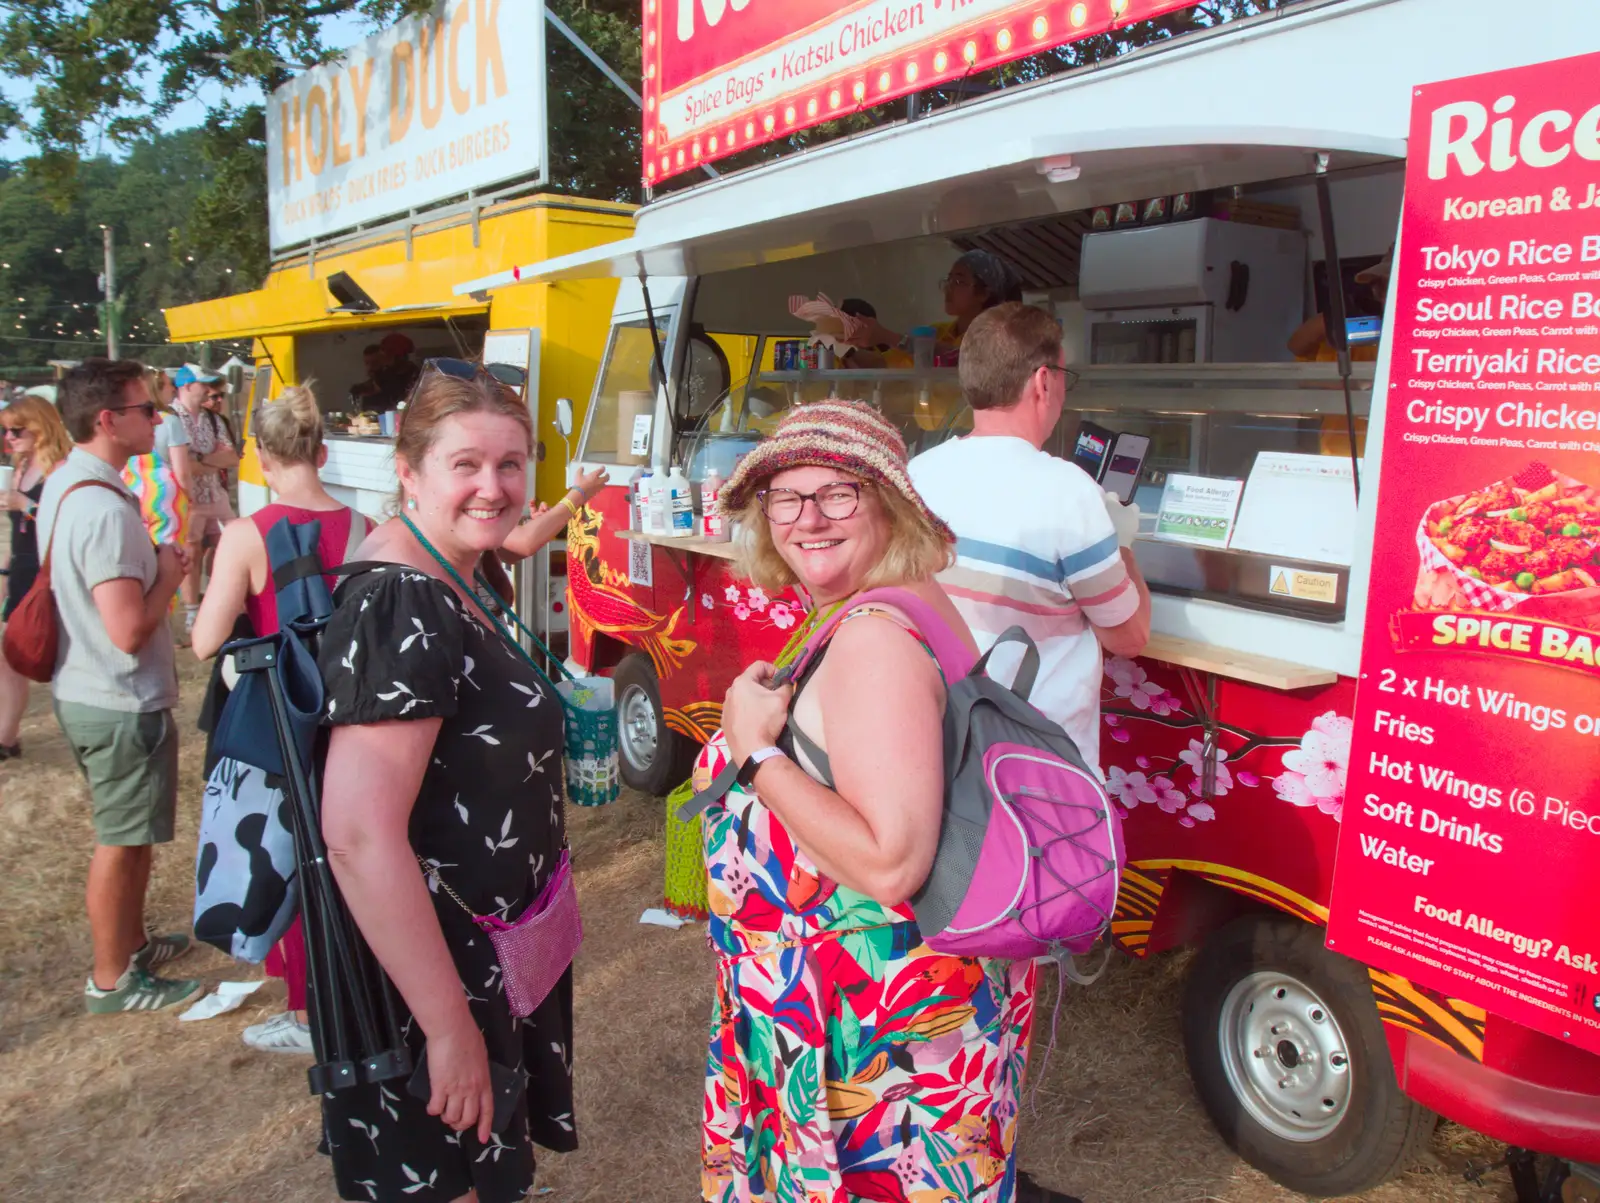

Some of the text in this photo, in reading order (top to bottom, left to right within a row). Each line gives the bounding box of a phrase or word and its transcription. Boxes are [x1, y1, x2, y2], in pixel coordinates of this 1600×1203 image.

[684, 2, 925, 125] Spice Bags Katsu Chicken
[281, 0, 509, 186] HOLY DUCK
[285, 121, 511, 226] DUCK WRAPS DUCK FRIES DUCK BURGERS
[1443, 195, 1542, 221] Korean
[1549, 187, 1572, 212] &
[1420, 244, 1500, 275] Tokyo
[1507, 239, 1572, 266] Rice
[1418, 278, 1446, 289] Crispy
[1447, 276, 1486, 287] Chicken,
[1488, 274, 1518, 285] Green
[1519, 273, 1546, 284] Peas,
[1548, 271, 1580, 282] Carrot
[1415, 295, 1493, 322] Seoul
[1499, 293, 1563, 320] Rice
[1412, 325, 1598, 340] Crispy Chicken, Green Peas, Carrot with
[1411, 348, 1600, 380] Terriyaki Rice
[1408, 379, 1436, 391] Crispy
[1436, 379, 1475, 390] Chicken,
[1477, 380, 1506, 391] Green
[1507, 381, 1534, 391] Peas,
[1535, 381, 1567, 391] Carrot
[1569, 381, 1592, 391] with
[1406, 399, 1600, 433] Crispy Chicke
[1403, 432, 1431, 444] Crispy
[1431, 434, 1469, 446] Chicken,
[1470, 436, 1499, 447] Green
[1499, 437, 1525, 448] Peas,
[1526, 439, 1559, 450] Carrot
[1559, 441, 1581, 451] with
[1185, 486, 1235, 498] Food Allergy?
[1296, 575, 1331, 588] Caution
[1432, 614, 1533, 652] SPICE
[1378, 668, 1397, 692] 2
[1402, 678, 1418, 698] x
[1423, 676, 1471, 709] Hot
[1477, 686, 1566, 731] Wings
[1373, 709, 1435, 745] Fries
[1368, 751, 1413, 784] Hot
[1419, 763, 1503, 809] Wings
[1509, 787, 1535, 817] (6
[1363, 793, 1503, 854] Soft Drinks
[1359, 833, 1435, 876] Water
[1413, 895, 1599, 975] Food Allergy? Ask
[1425, 933, 1439, 943] food
[1367, 935, 1392, 950] PLEASE
[1392, 945, 1406, 955] ASK
[1412, 952, 1442, 969] MEMBER
[1442, 964, 1453, 973] OF
[1453, 968, 1476, 982] STAFF
[1475, 977, 1502, 991] ABOUT
[1502, 986, 1518, 998] THE
[1518, 992, 1572, 1018] INGREDIENTS
[1572, 1013, 1583, 1022] IN
